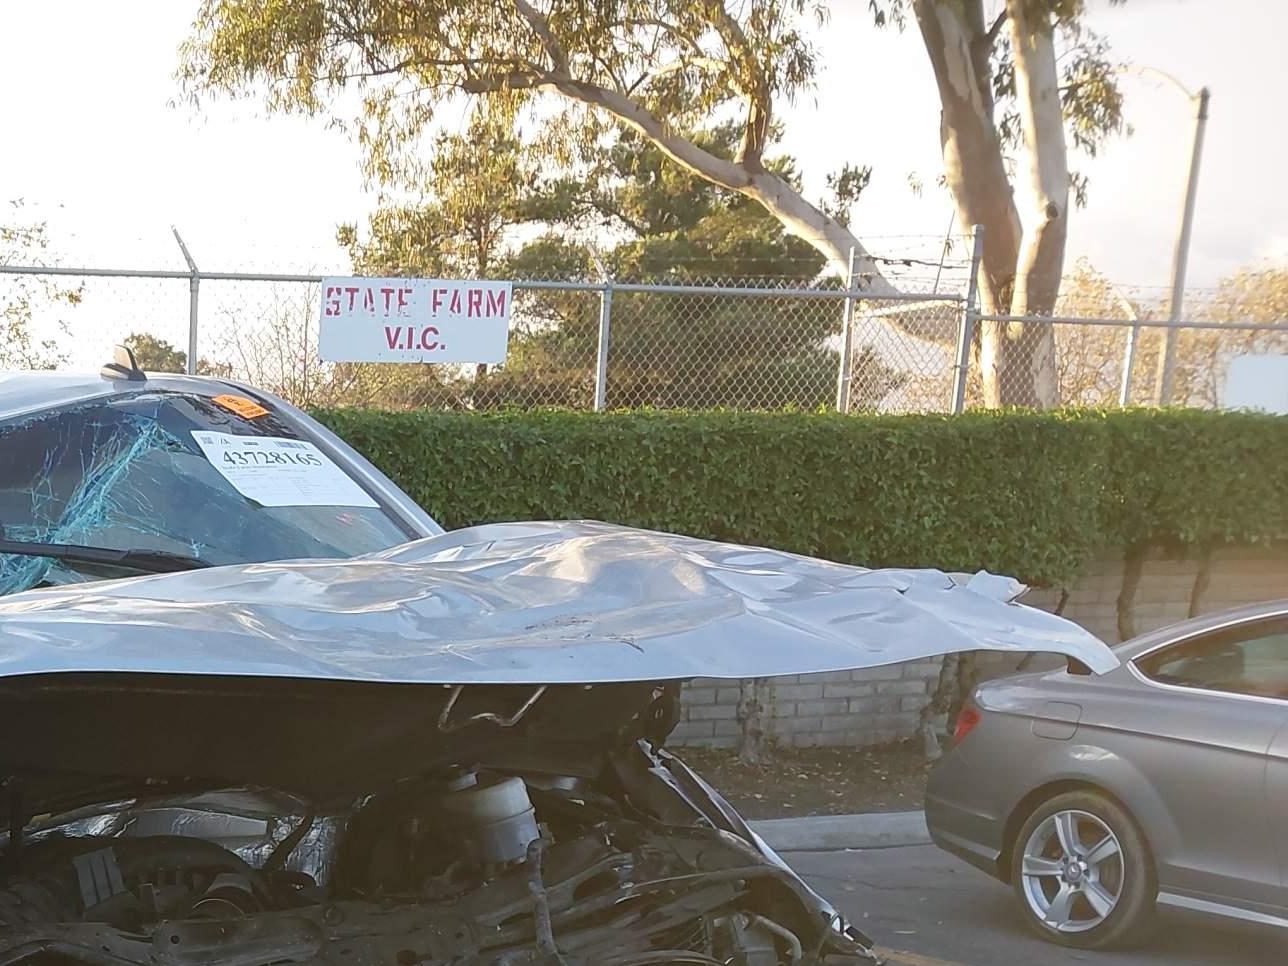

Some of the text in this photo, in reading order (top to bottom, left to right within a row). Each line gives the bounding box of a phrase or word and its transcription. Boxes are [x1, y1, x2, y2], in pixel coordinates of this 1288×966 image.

[325, 287, 507, 318] STATE FARM
[384, 326, 446, 351] V.I.C.
[223, 450, 322, 467] 43728165
